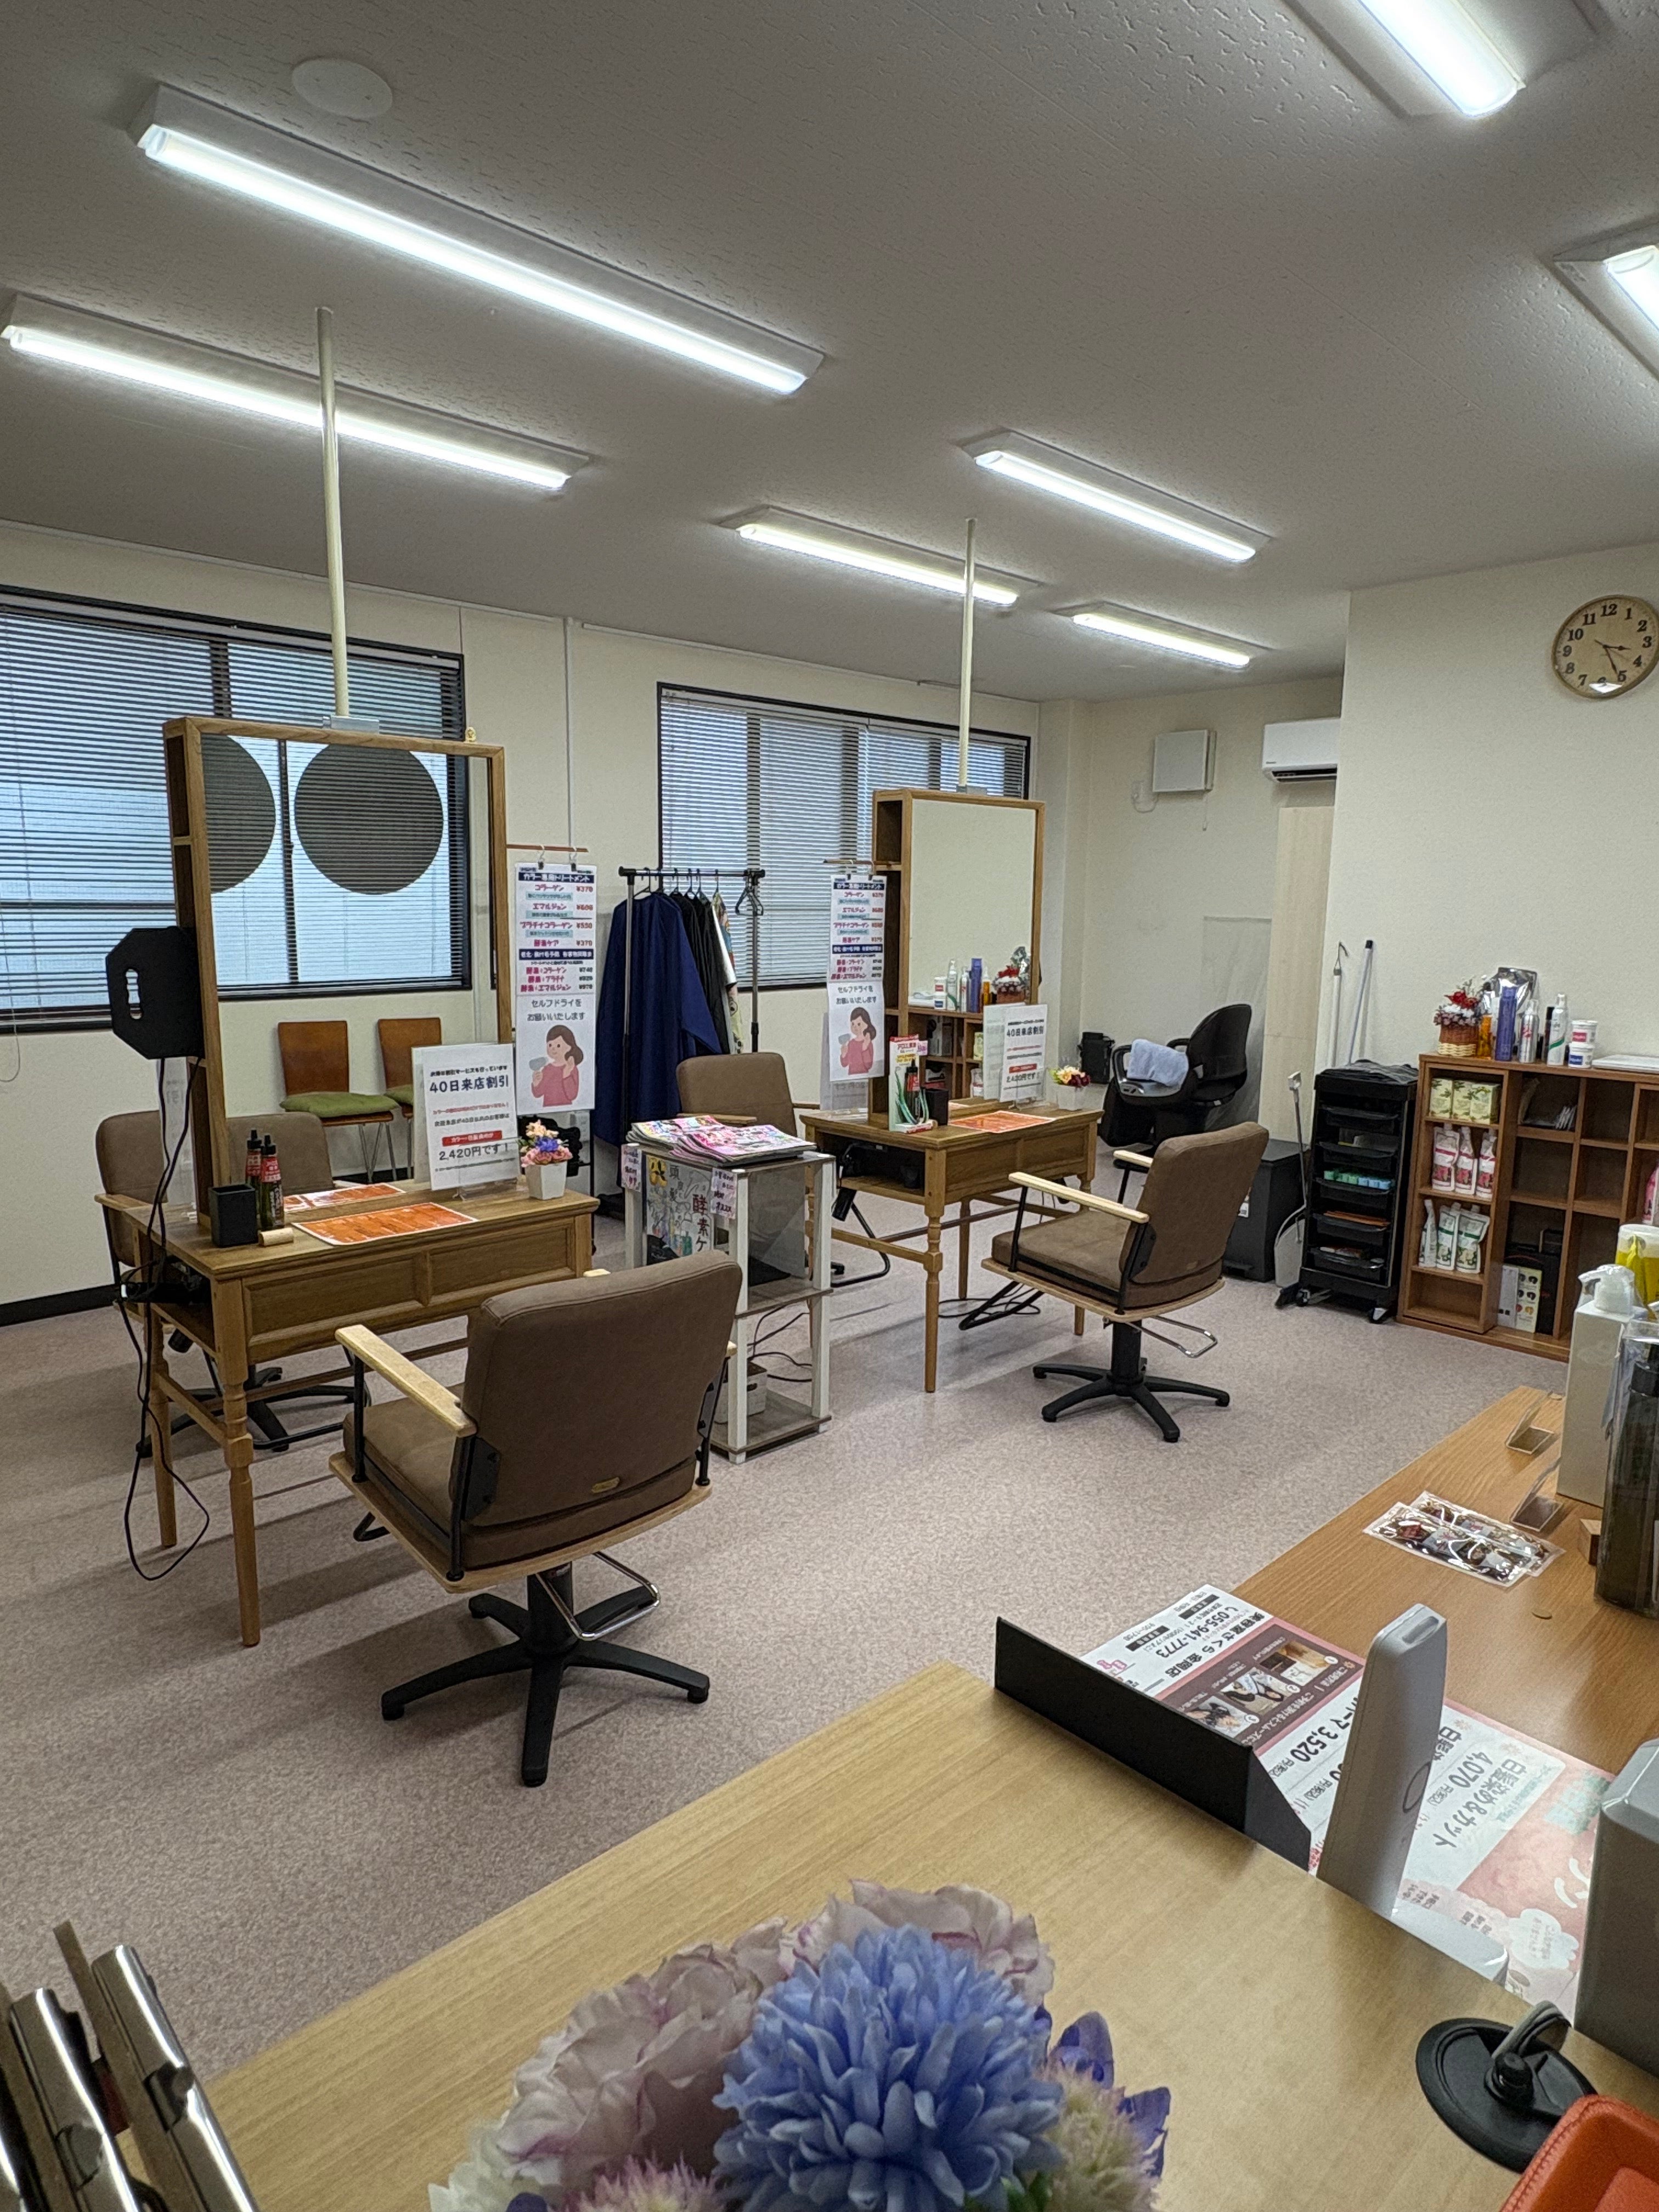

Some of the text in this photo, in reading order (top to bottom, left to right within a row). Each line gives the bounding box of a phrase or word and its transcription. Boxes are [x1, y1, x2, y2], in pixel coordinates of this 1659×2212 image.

[1600, 603, 1618, 617] 12
[1624, 607, 1633, 620] 1
[1583, 613, 1596, 626] 11
[1637, 620, 1647, 633] 2
[1567, 628, 1584, 641] 10
[1642, 636, 1652, 648] 3
[1562, 645, 1572, 657] 9
[1633, 654, 1642, 668] 4
[1565, 662, 1575, 674] 8
[1578, 674, 1588, 686] 7
[1617, 670, 1627, 682] 5
[534, 883, 565, 892] コラーゲン
[531, 998, 582, 1008] セルフドライを
[527, 1012, 585, 1022] お願いいたします
[429, 1074, 509, 1093] 40日来店割引
[1155, 1611, 1230, 1658] 055-941-7773
[1201, 1612, 1265, 1654] 美容室さくら
[1290, 1726, 1339, 1762] 3,520
[1448, 1752, 1493, 1788] 4,070
[1432, 1759, 1527, 1848] 白髪染め&カット
